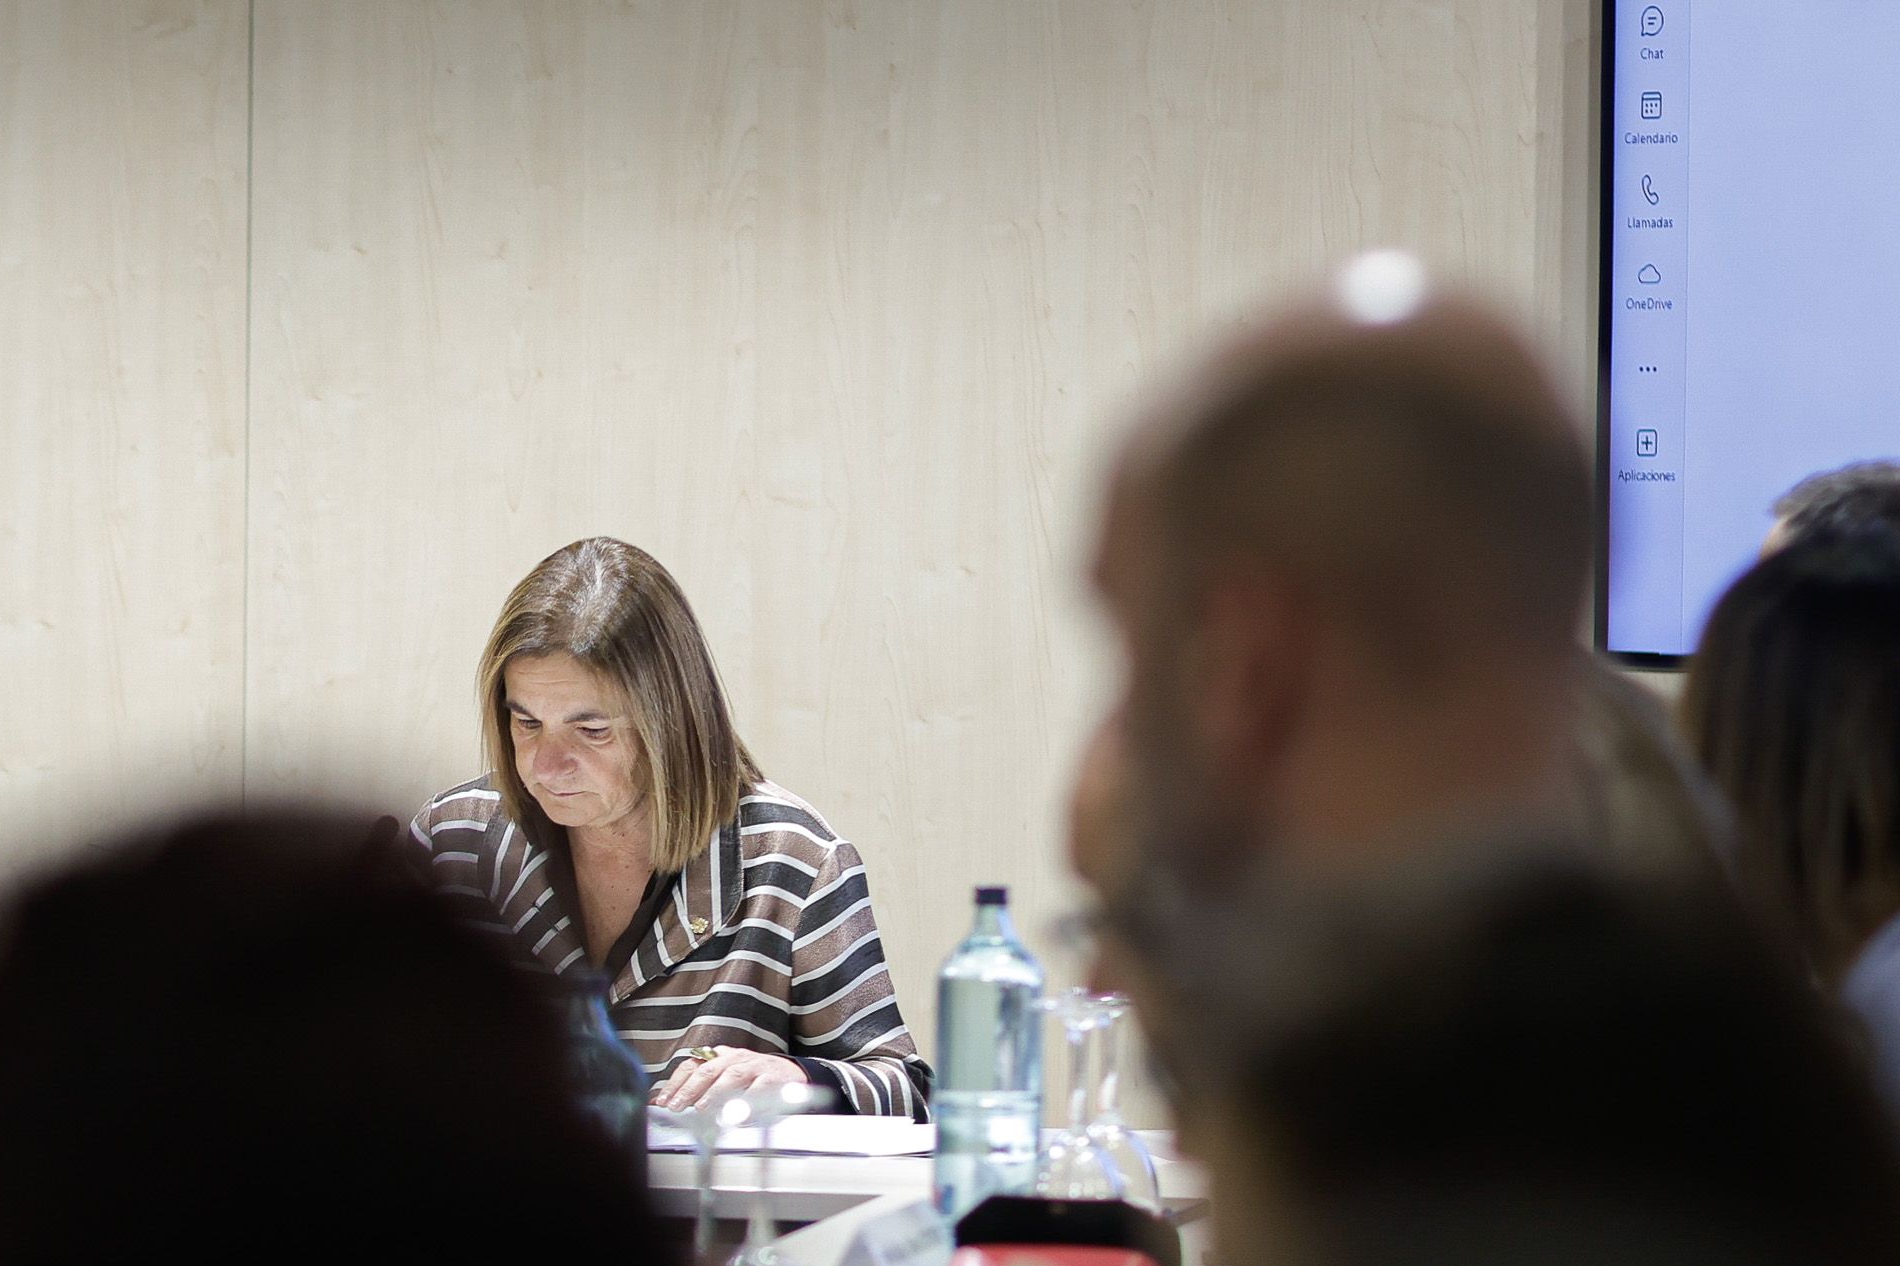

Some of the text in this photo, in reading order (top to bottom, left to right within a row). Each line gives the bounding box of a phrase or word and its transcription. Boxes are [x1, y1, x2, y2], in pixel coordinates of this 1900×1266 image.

[1640, 47, 1664, 60] Chat
[1624, 132, 1679, 145] Calendario
[1627, 217, 1674, 229] Llamadas
[1626, 297, 1673, 311] OneDrive
[1618, 469, 1676, 483] Aplicaciones
